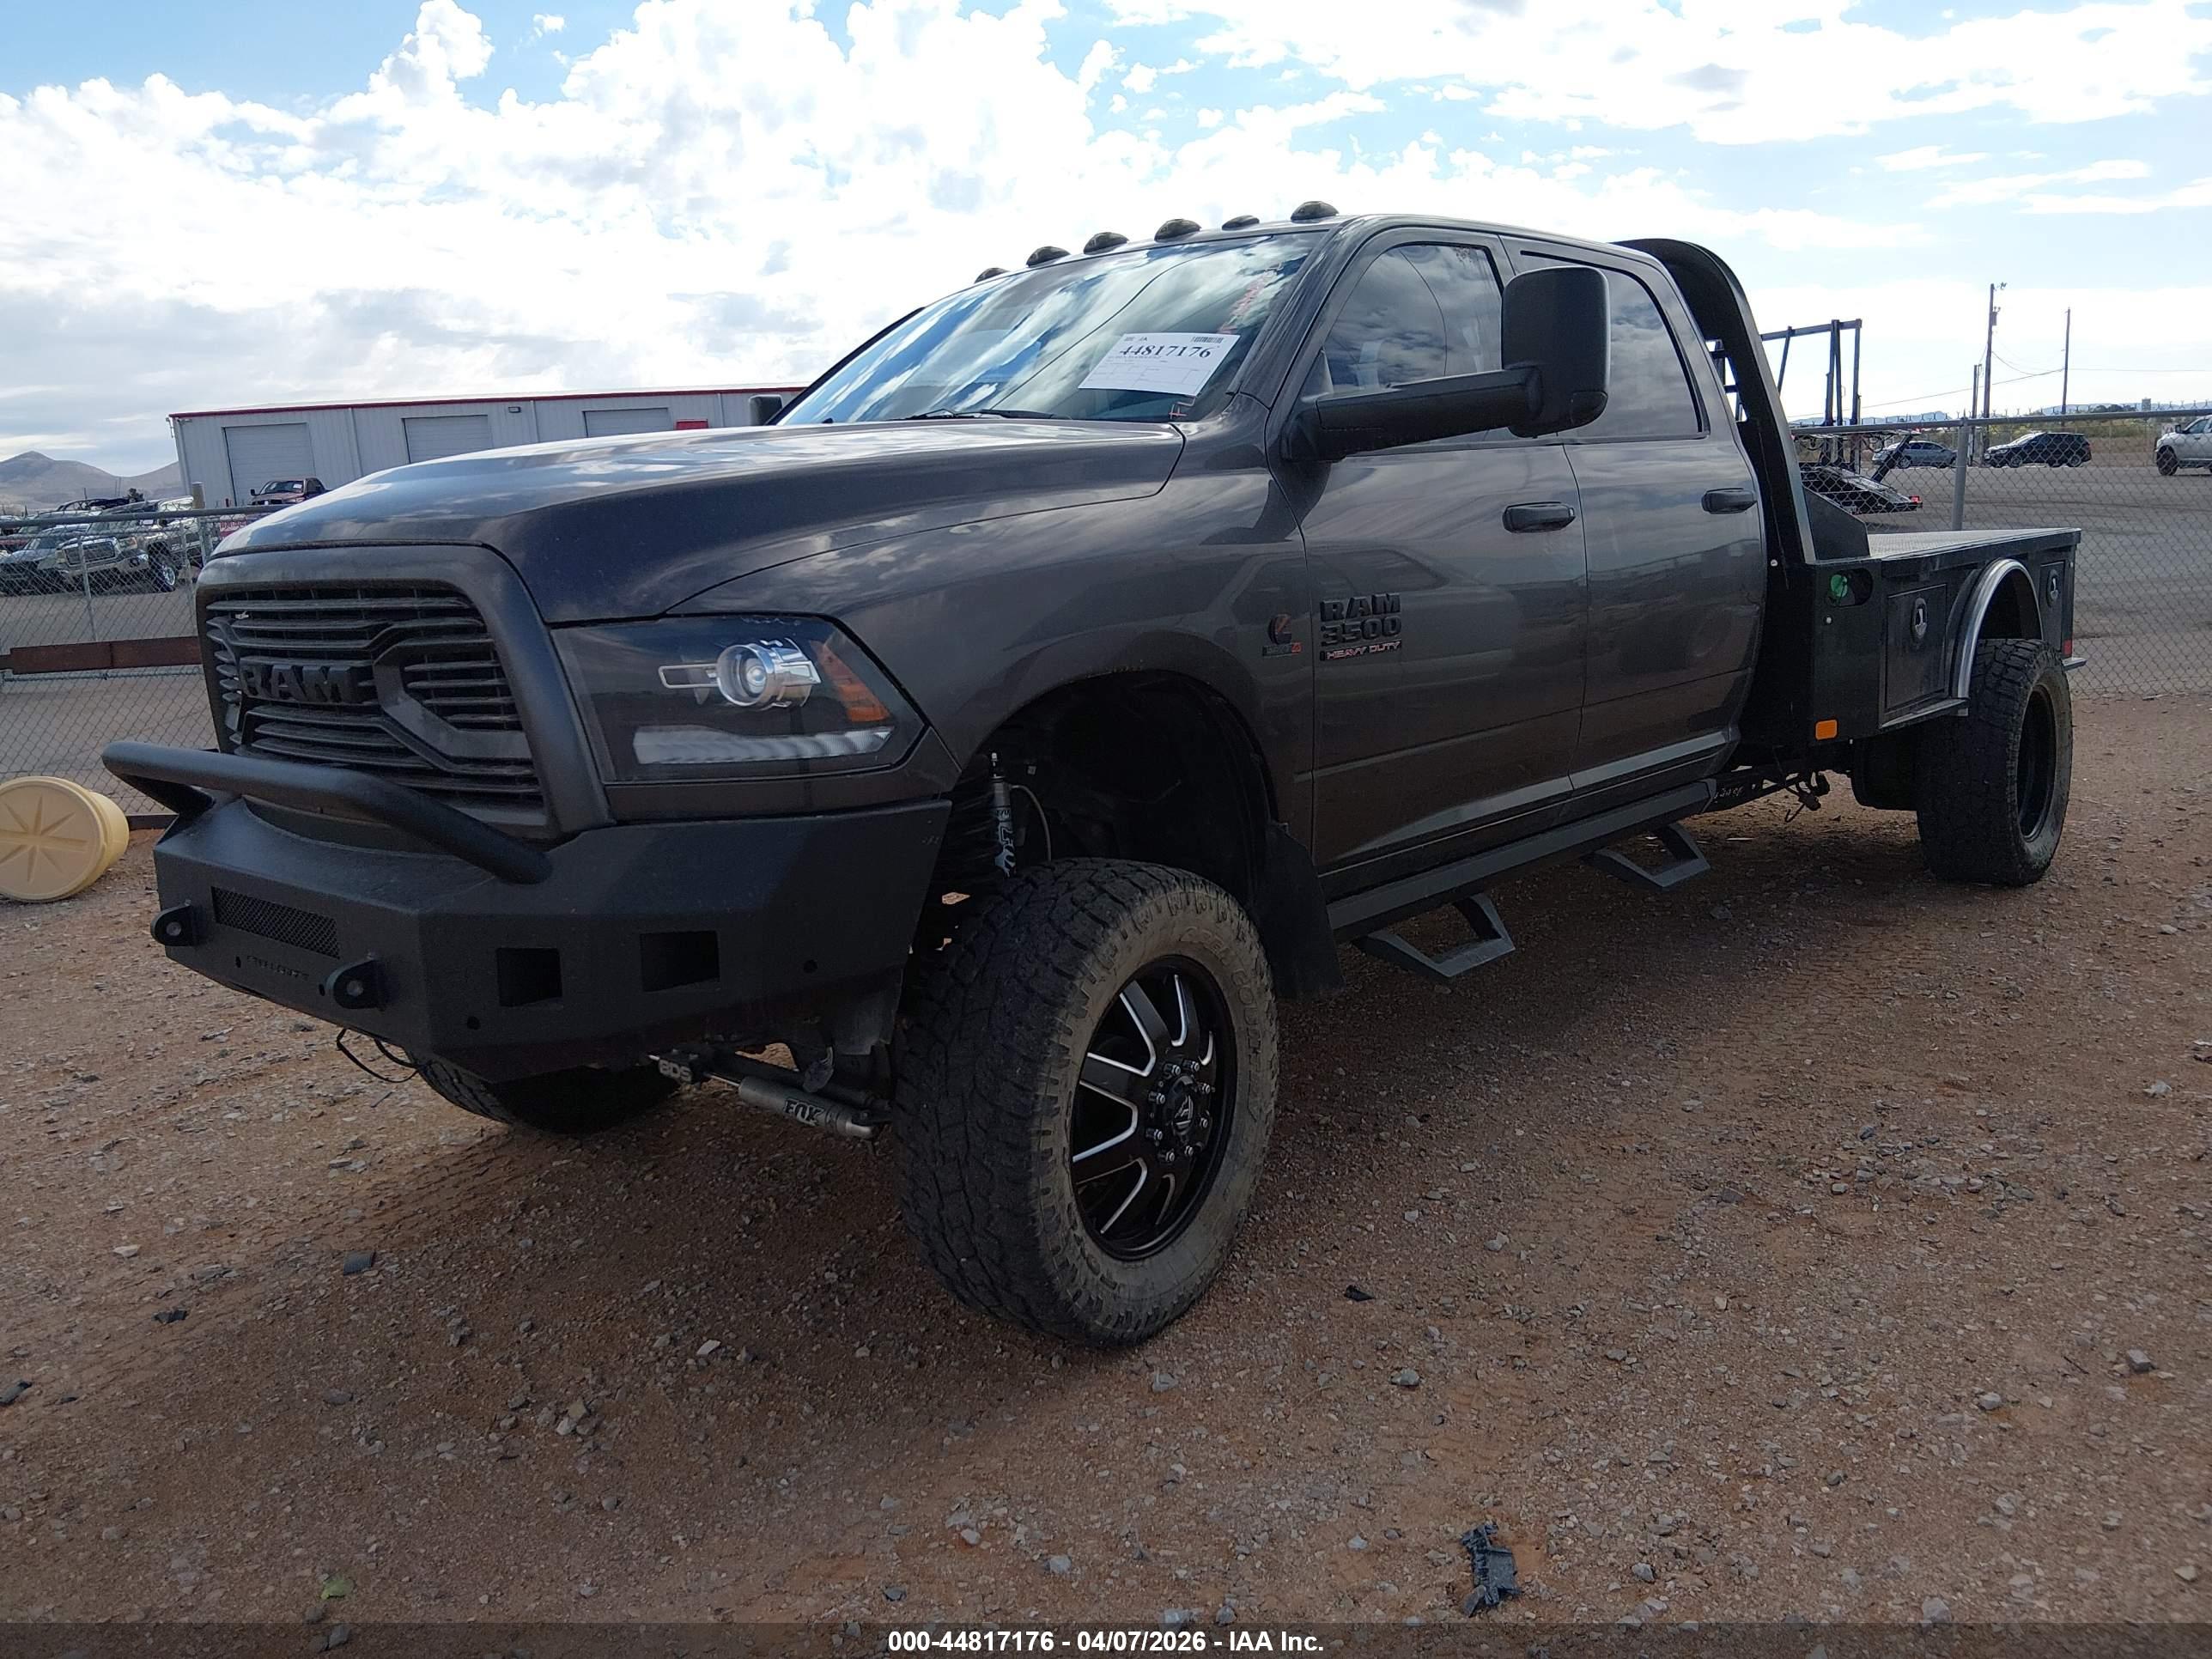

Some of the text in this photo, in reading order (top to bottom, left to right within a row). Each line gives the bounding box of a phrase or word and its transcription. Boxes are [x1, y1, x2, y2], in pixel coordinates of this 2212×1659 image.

[1120, 344, 1215, 358] 44817176
[1320, 592, 1401, 622] RAM
[1321, 616, 1401, 647] 3500
[1327, 640, 1401, 659] HEAVY DUTY
[240, 664, 351, 702] RAM
[659, 1059, 693, 1083] BDS
[785, 1097, 825, 1127] FOX
